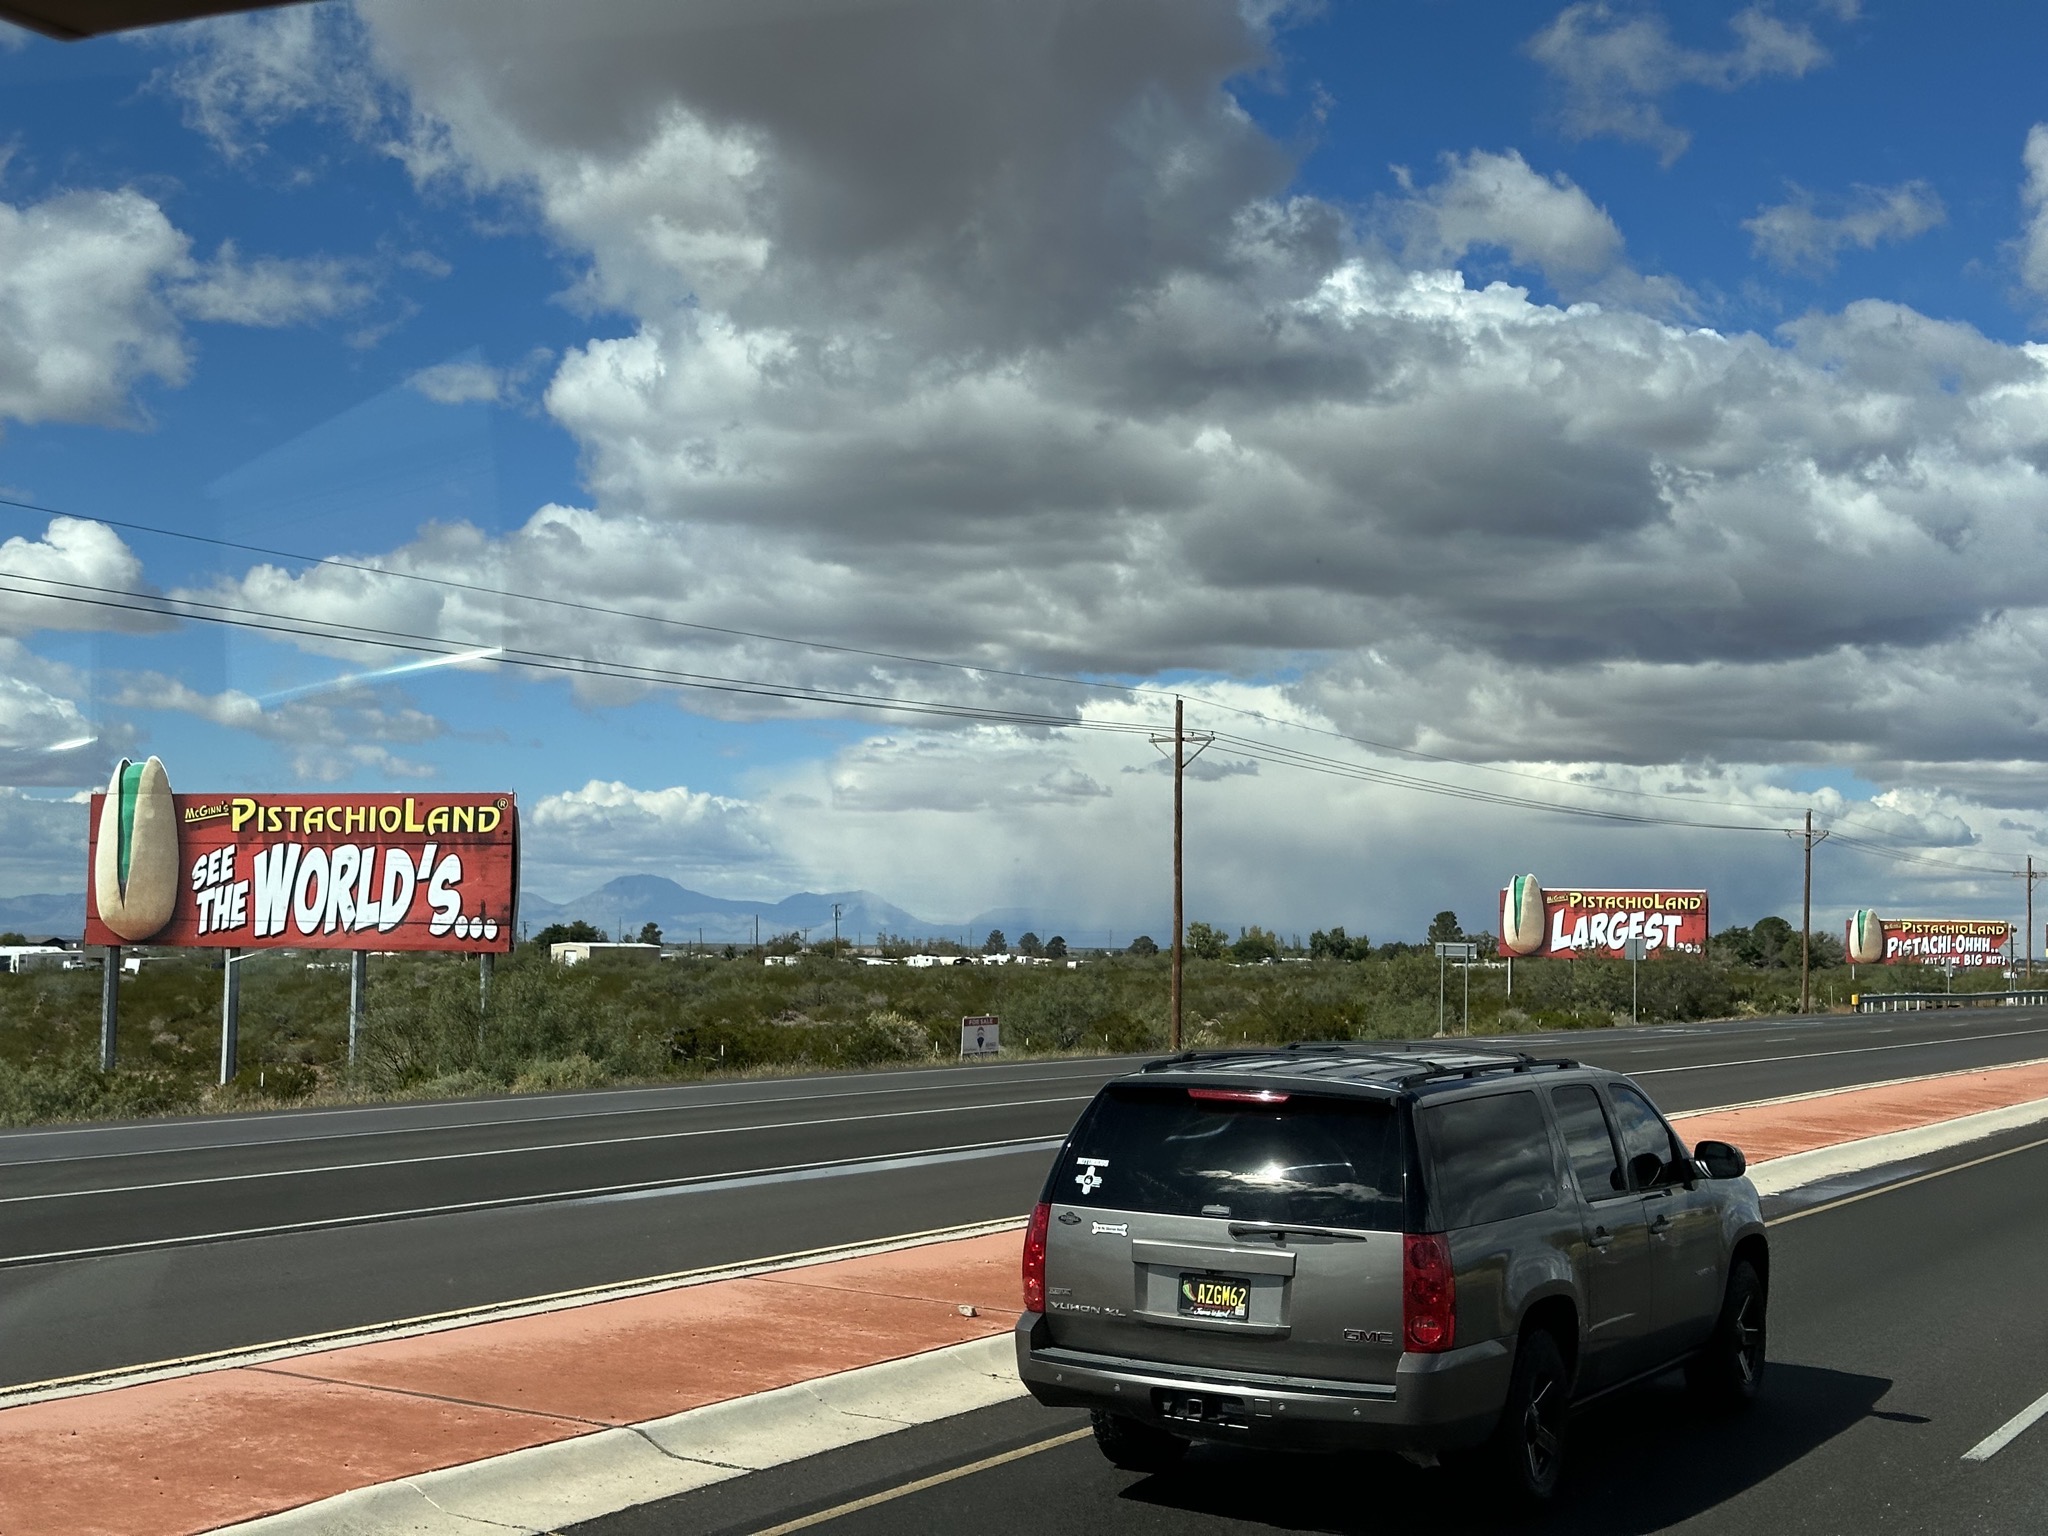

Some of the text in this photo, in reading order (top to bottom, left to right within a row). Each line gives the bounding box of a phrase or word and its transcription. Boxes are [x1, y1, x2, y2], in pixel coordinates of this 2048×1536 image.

[191, 843, 237, 891] SEE
[195, 841, 498, 942] THE WORLD'S...
[1551, 908, 1702, 954] LARGEST...
[1964, 954, 1982, 966] BIG
[1197, 1284, 1247, 1306] AZGM62
[1050, 1301, 1127, 1317] YUKON XL
[1343, 1328, 1393, 1344] GMC
